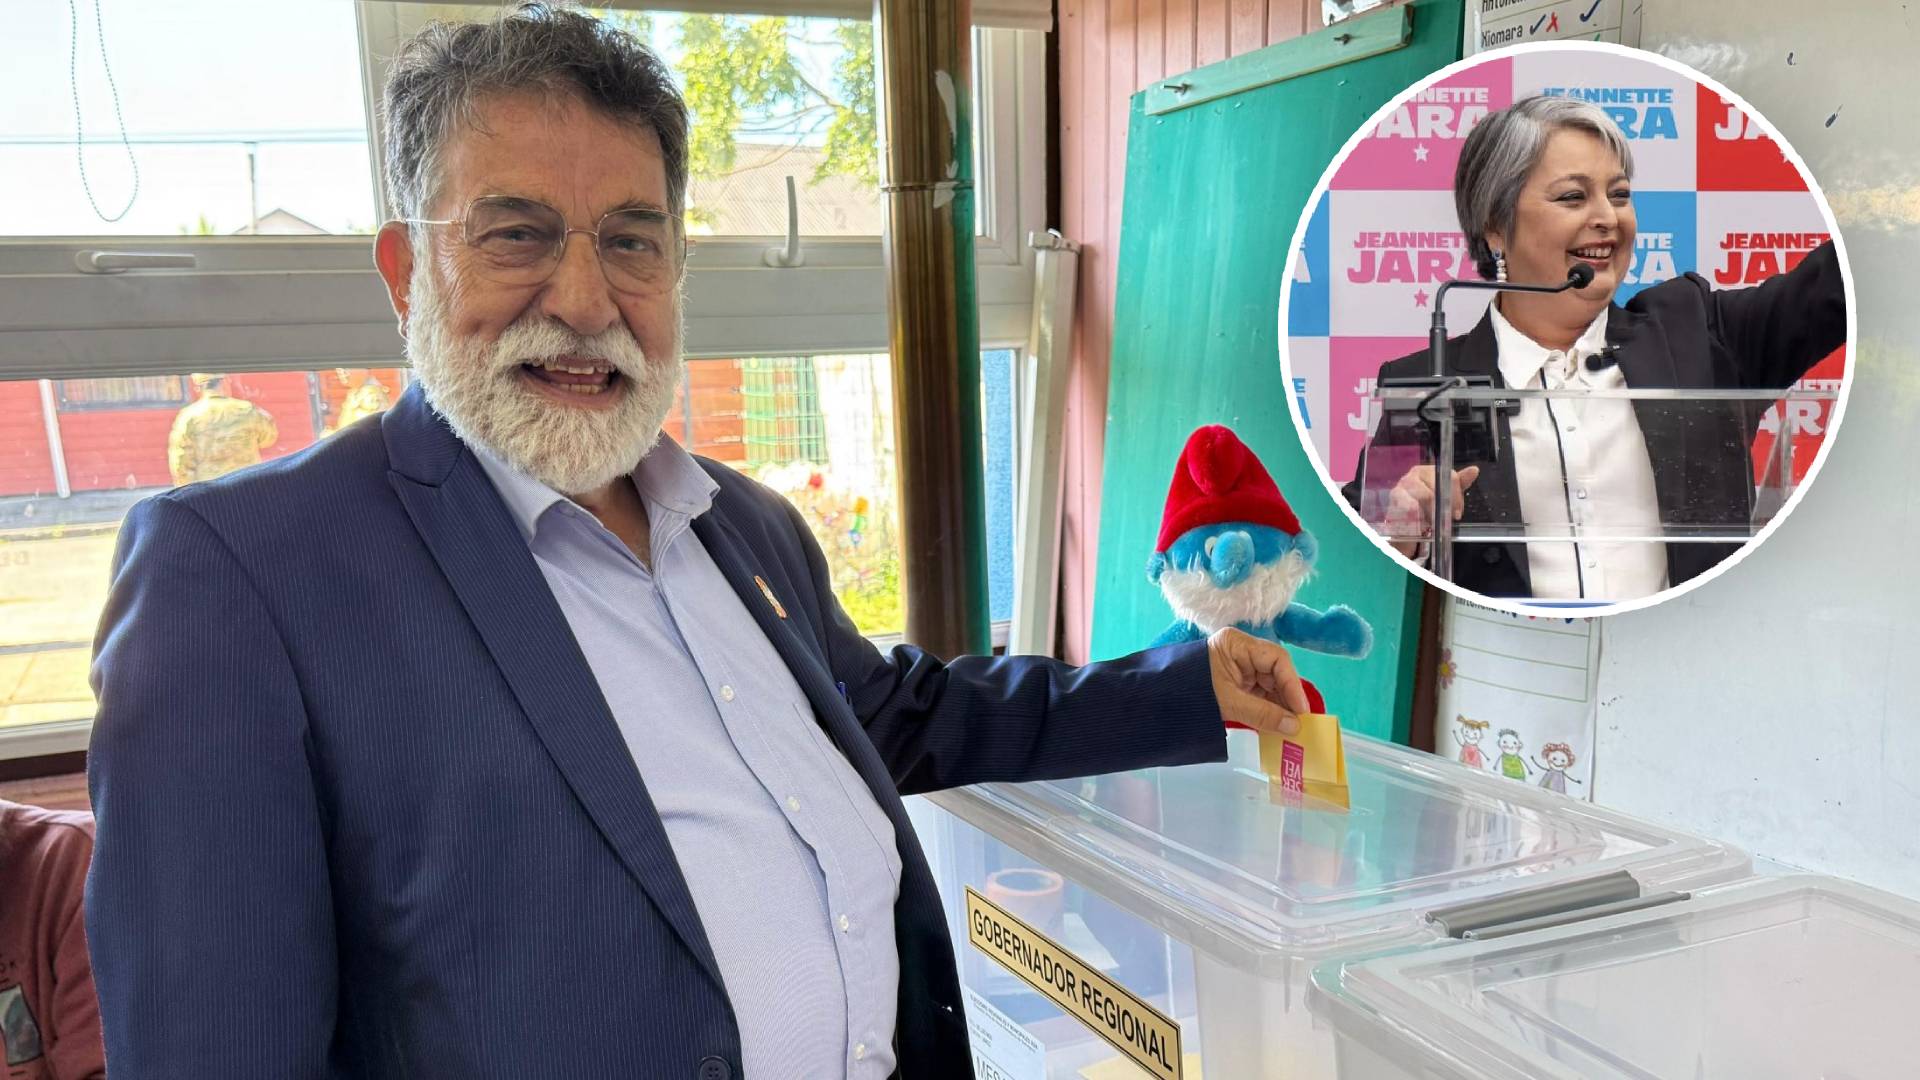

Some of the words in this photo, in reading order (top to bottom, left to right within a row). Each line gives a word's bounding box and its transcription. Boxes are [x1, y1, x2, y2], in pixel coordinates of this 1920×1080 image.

[1481, 25, 1523, 48] Xiomara
[1408, 88, 1488, 103] NETTE
[1366, 105, 1488, 139] ARA
[1601, 106, 1679, 139] RA
[1353, 232, 1469, 249] JEANNET
[1720, 233, 1831, 249] JEANNET
[973, 908, 1078, 1003] GOBERNADOR
[1081, 979, 1173, 1072] REGIONAL
